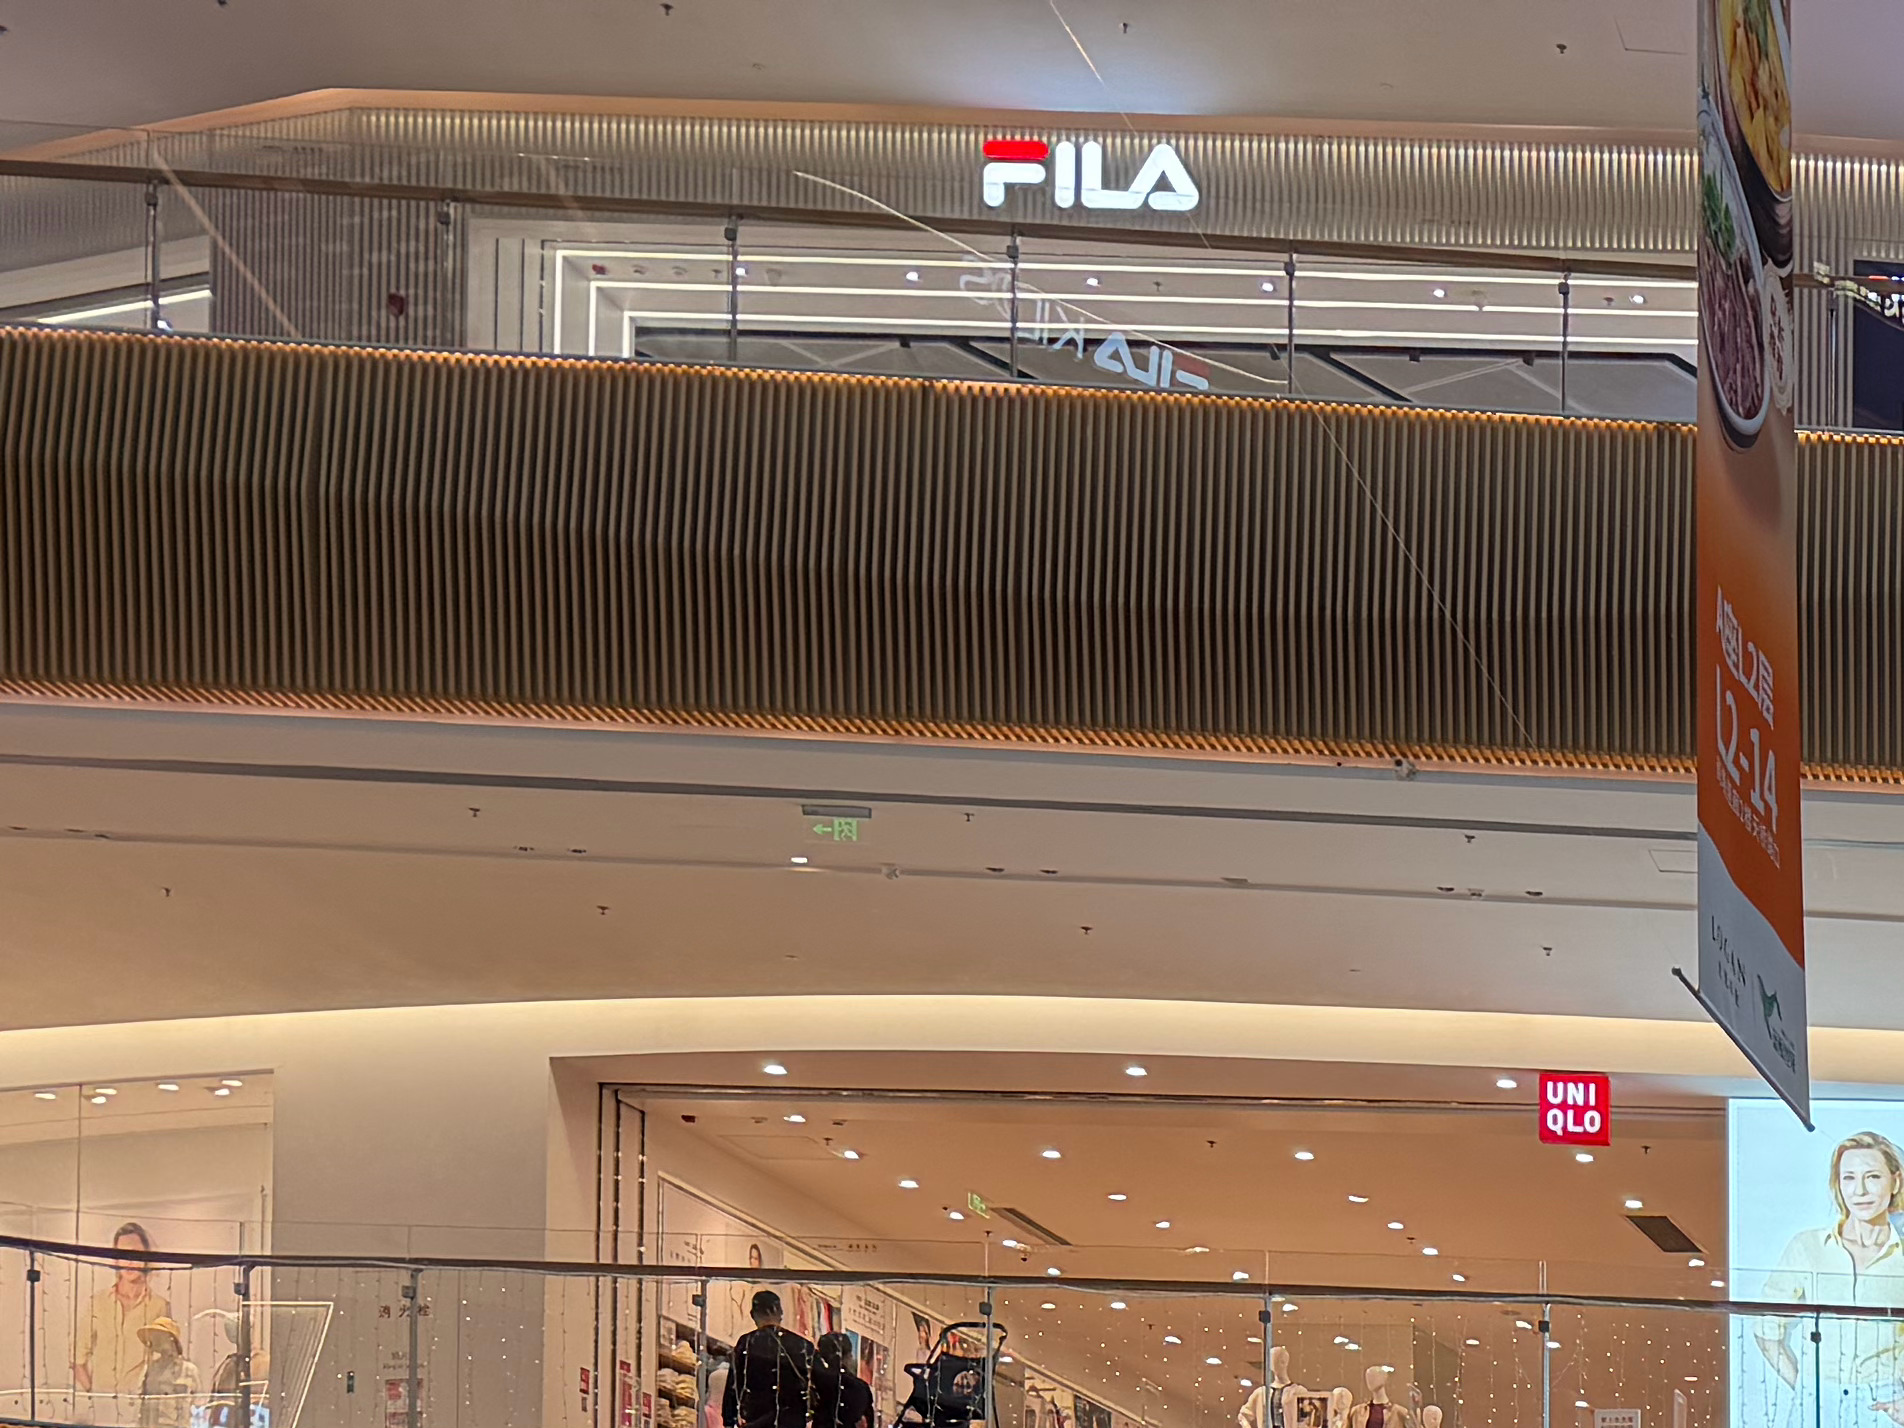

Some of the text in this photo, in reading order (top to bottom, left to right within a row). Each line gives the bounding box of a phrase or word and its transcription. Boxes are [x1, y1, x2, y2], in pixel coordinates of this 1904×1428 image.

[982, 139, 1199, 212] FILA
[1547, 1082, 1597, 1105] UNI
[1546, 1109, 1602, 1135] QLO
